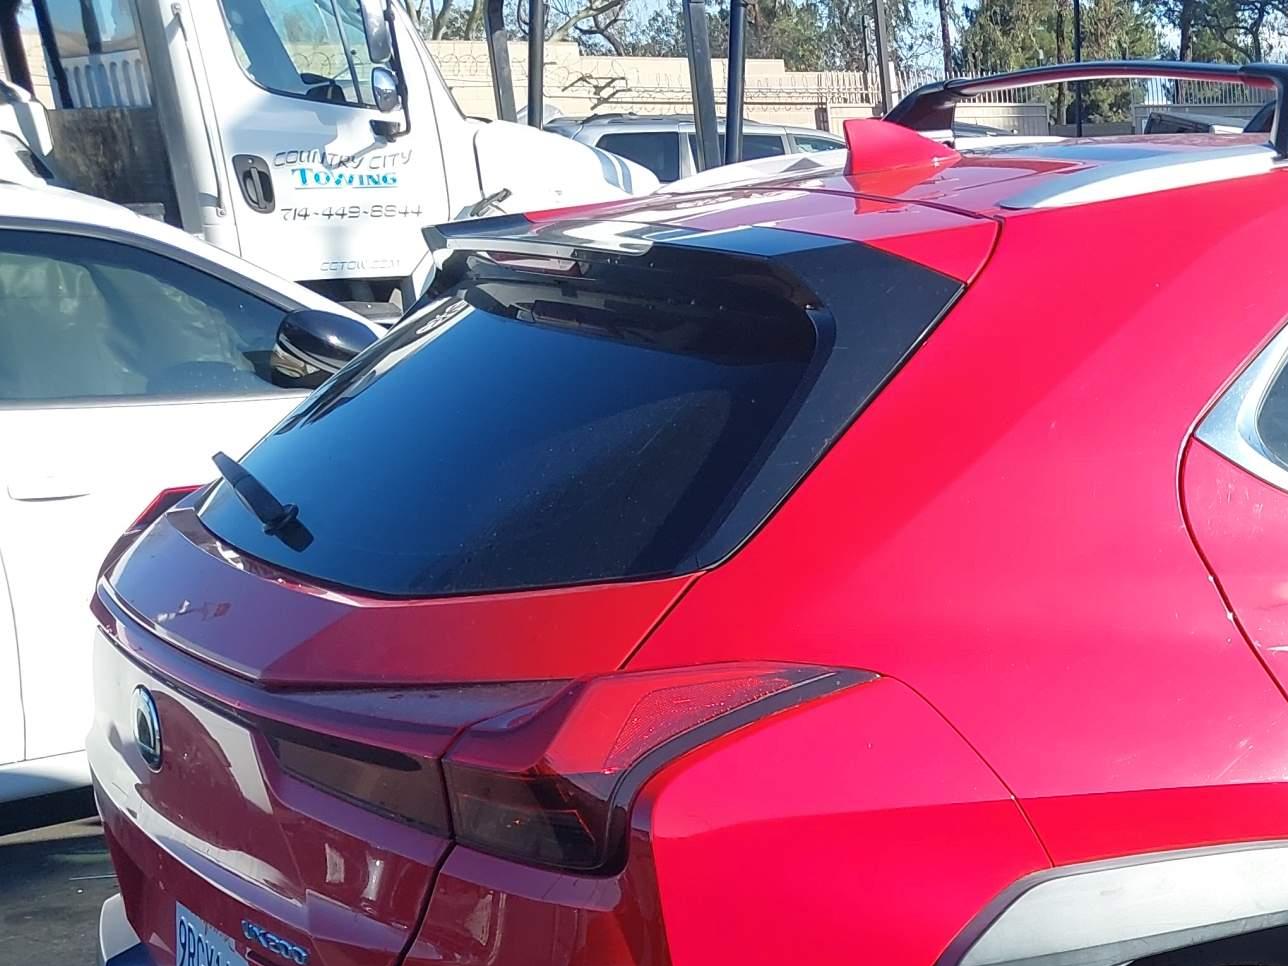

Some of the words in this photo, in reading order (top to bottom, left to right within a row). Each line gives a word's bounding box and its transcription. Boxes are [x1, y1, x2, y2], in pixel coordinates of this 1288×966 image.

[274, 150, 364, 168] COUNTRY
[369, 150, 412, 169] CITY
[291, 168, 397, 186] TOWING
[280, 204, 423, 221] 714-449-8844
[241, 920, 308, 965] UX200
